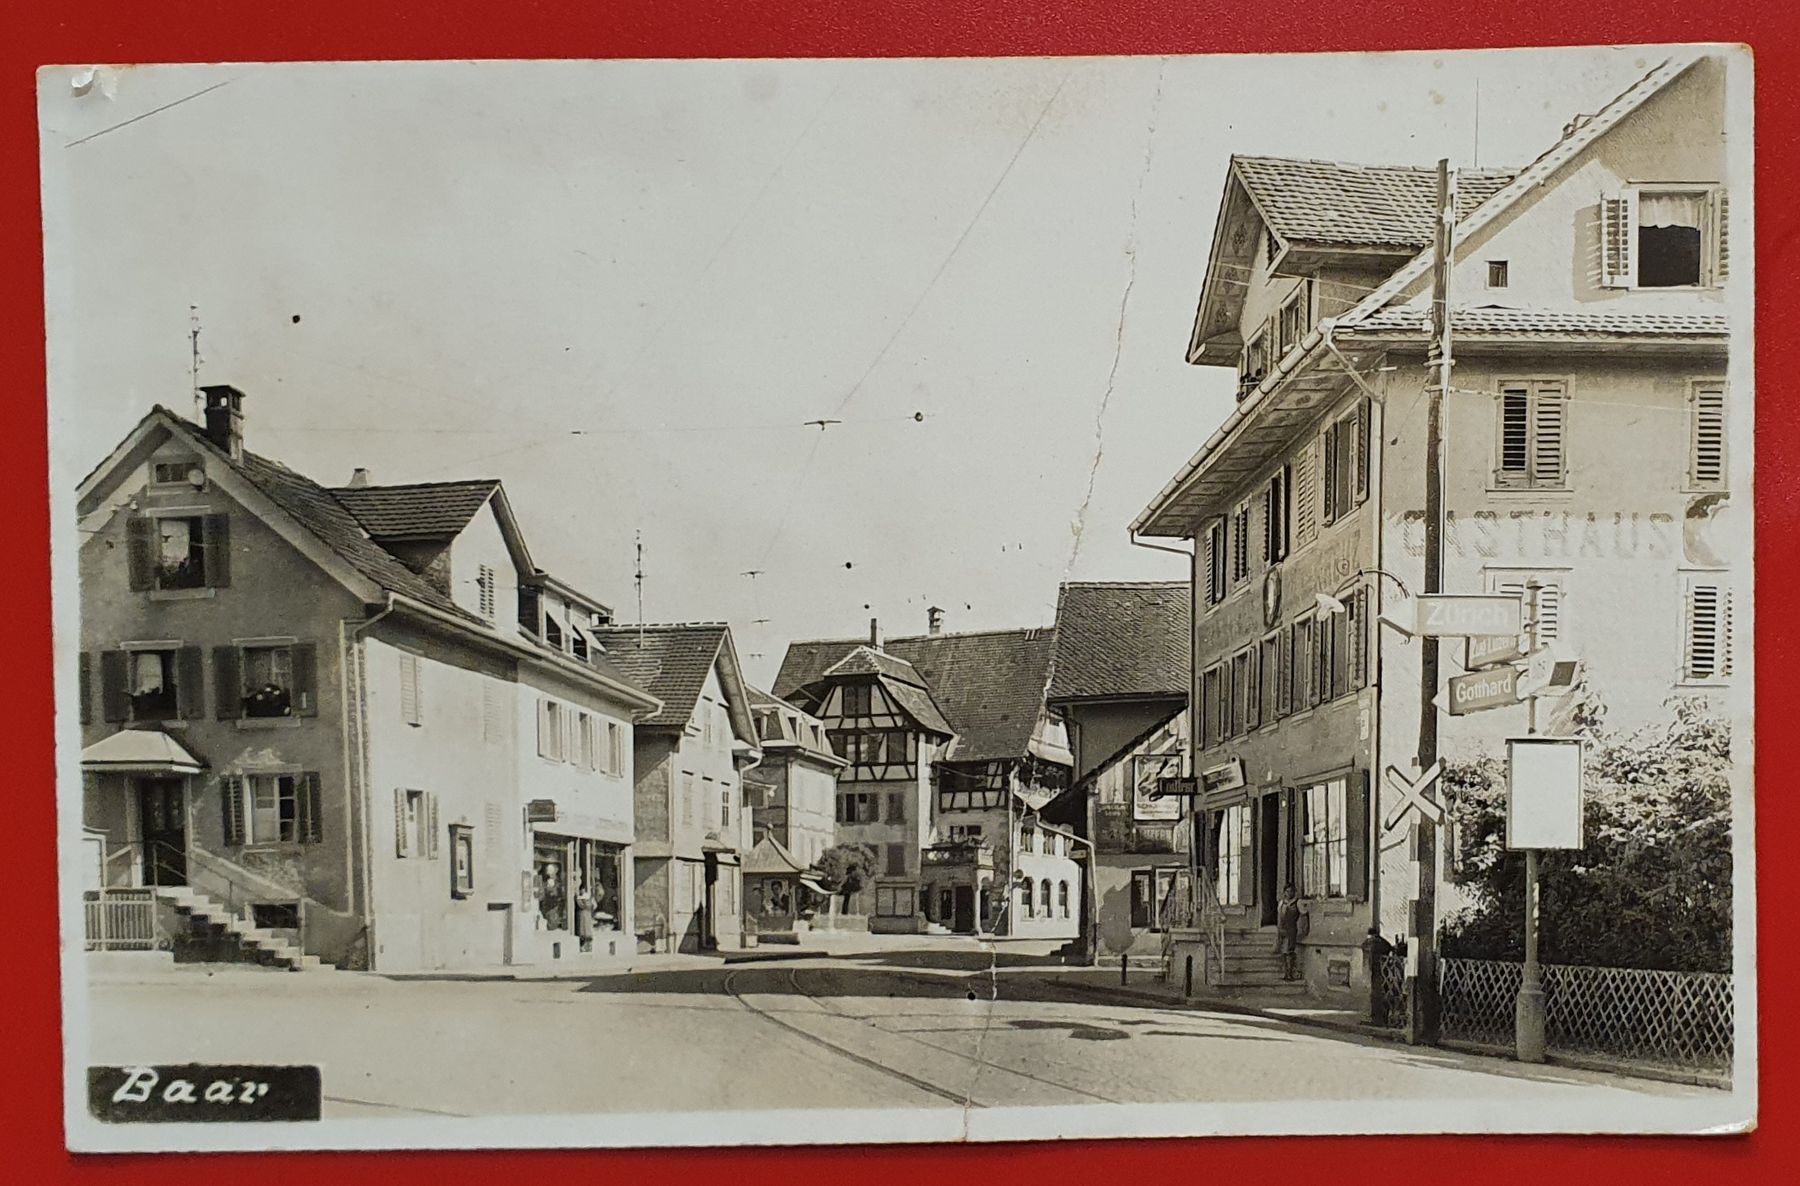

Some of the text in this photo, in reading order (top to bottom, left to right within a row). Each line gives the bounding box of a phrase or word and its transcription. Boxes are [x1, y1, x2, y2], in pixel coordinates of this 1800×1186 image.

[1426, 600, 1509, 625] Zürich
[1456, 673, 1512, 702] Gotthard
[112, 1066, 269, 1103] Baar
